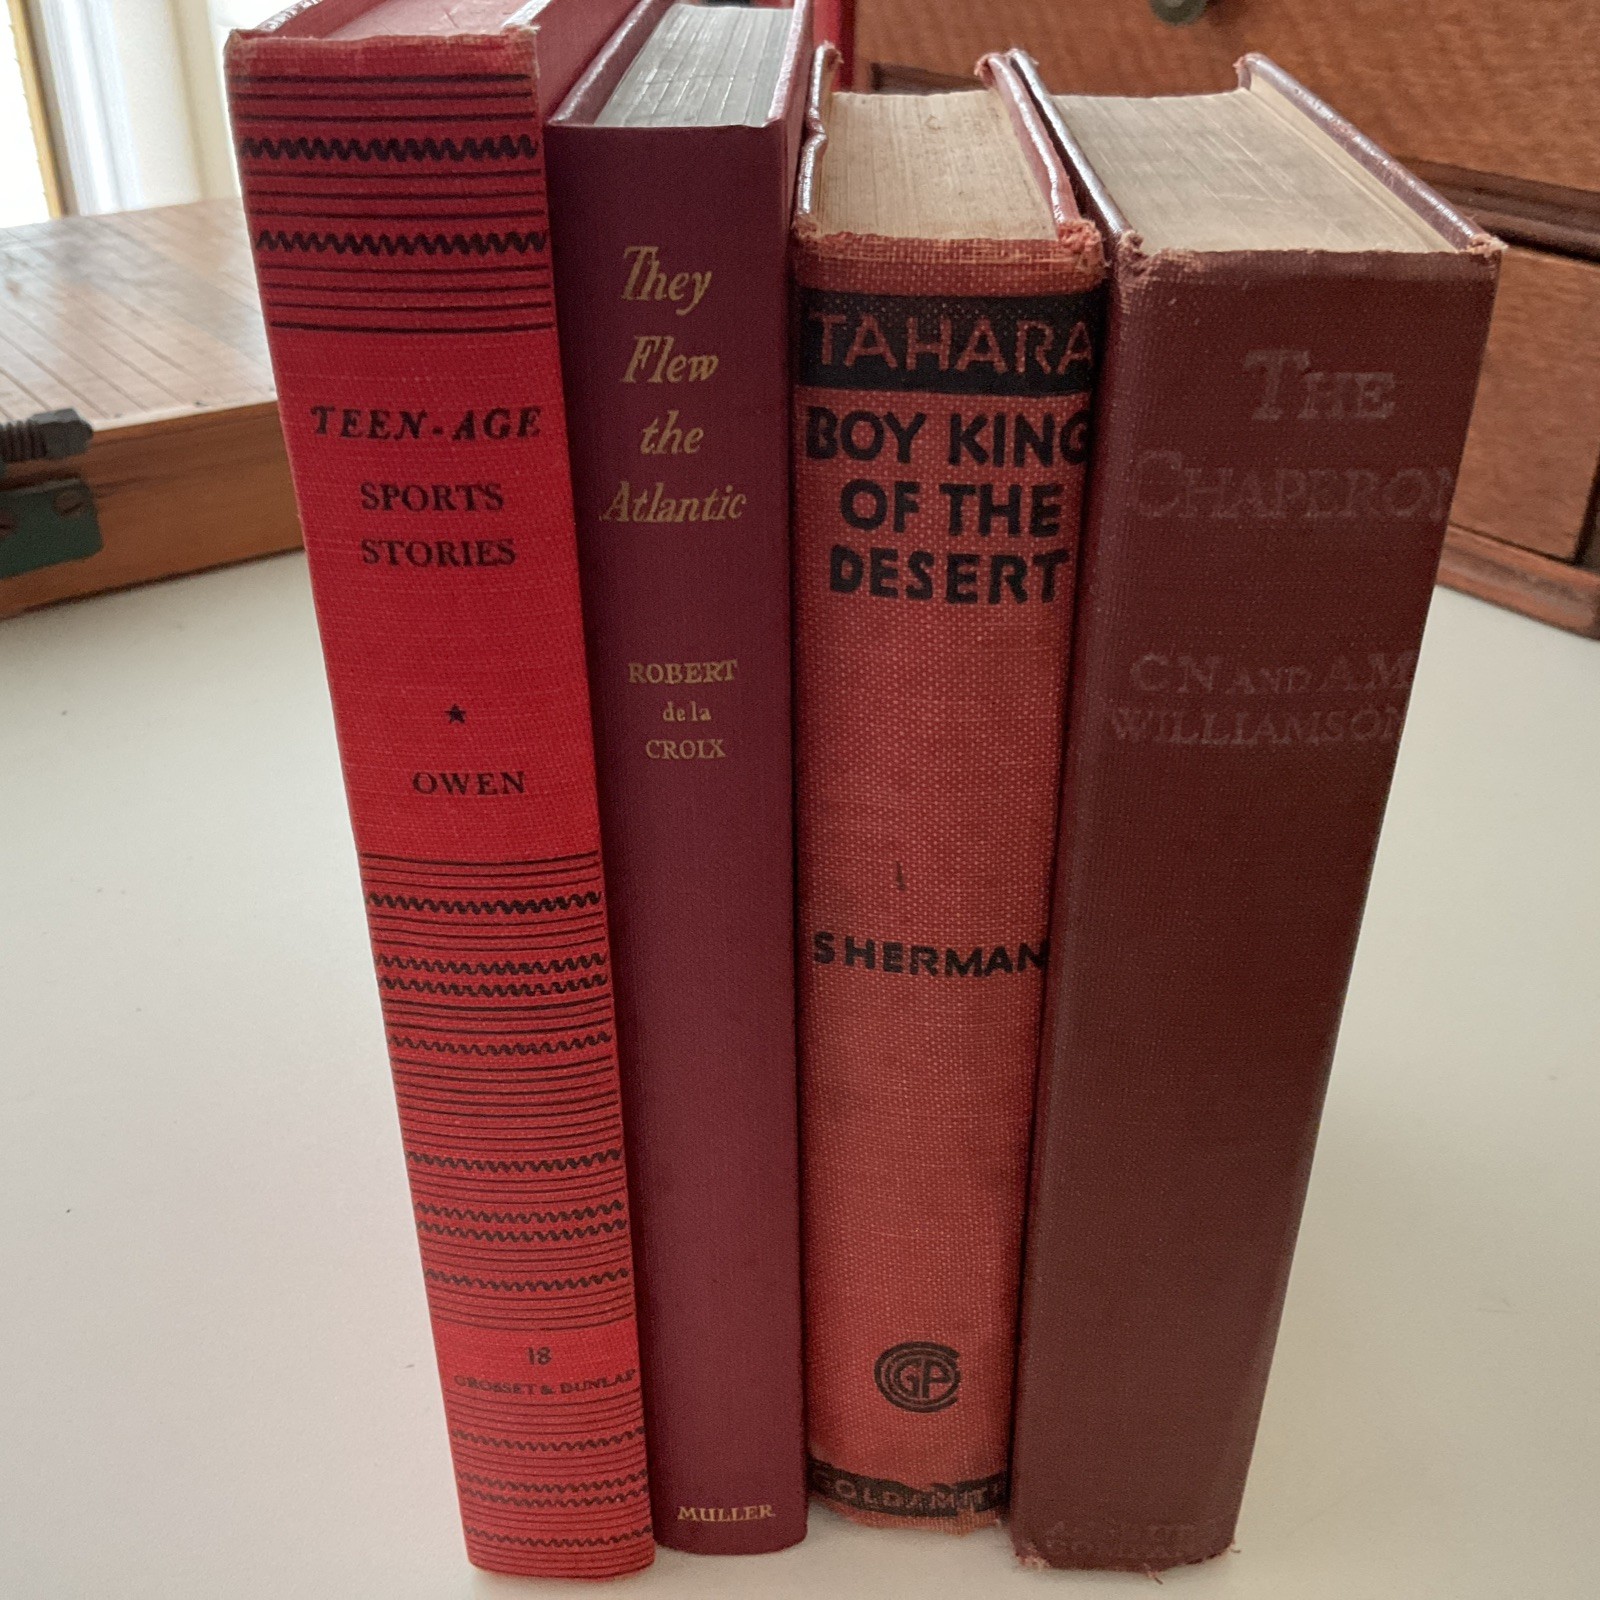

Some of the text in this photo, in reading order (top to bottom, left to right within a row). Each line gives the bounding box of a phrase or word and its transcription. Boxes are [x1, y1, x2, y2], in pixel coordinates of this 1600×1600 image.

[620, 245, 712, 315] They
[620, 335, 719, 383] Flew
[810, 312, 1093, 375] TAHARA
[310, 404, 542, 441] TEEN-AGE
[639, 410, 704, 454] the
[804, 405, 1091, 467] BOY KING
[359, 482, 505, 511] SPORTS
[600, 481, 748, 523] Atlantic
[839, 478, 1066, 538] OF THE
[360, 538, 517, 567] STORIES
[829, 544, 1070, 605] DESERT
[628, 659, 738, 684] ROBERT
[662, 700, 712, 721] de la
[645, 738, 726, 759] CROIX
[412, 771, 526, 796] OWEN
[812, 930, 1049, 978] SHERMAN
[528, 1347, 552, 1366] 18
[454, 1368, 637, 1396] GROSSET & DUNLAP
[677, 1504, 776, 1522] MULLER
